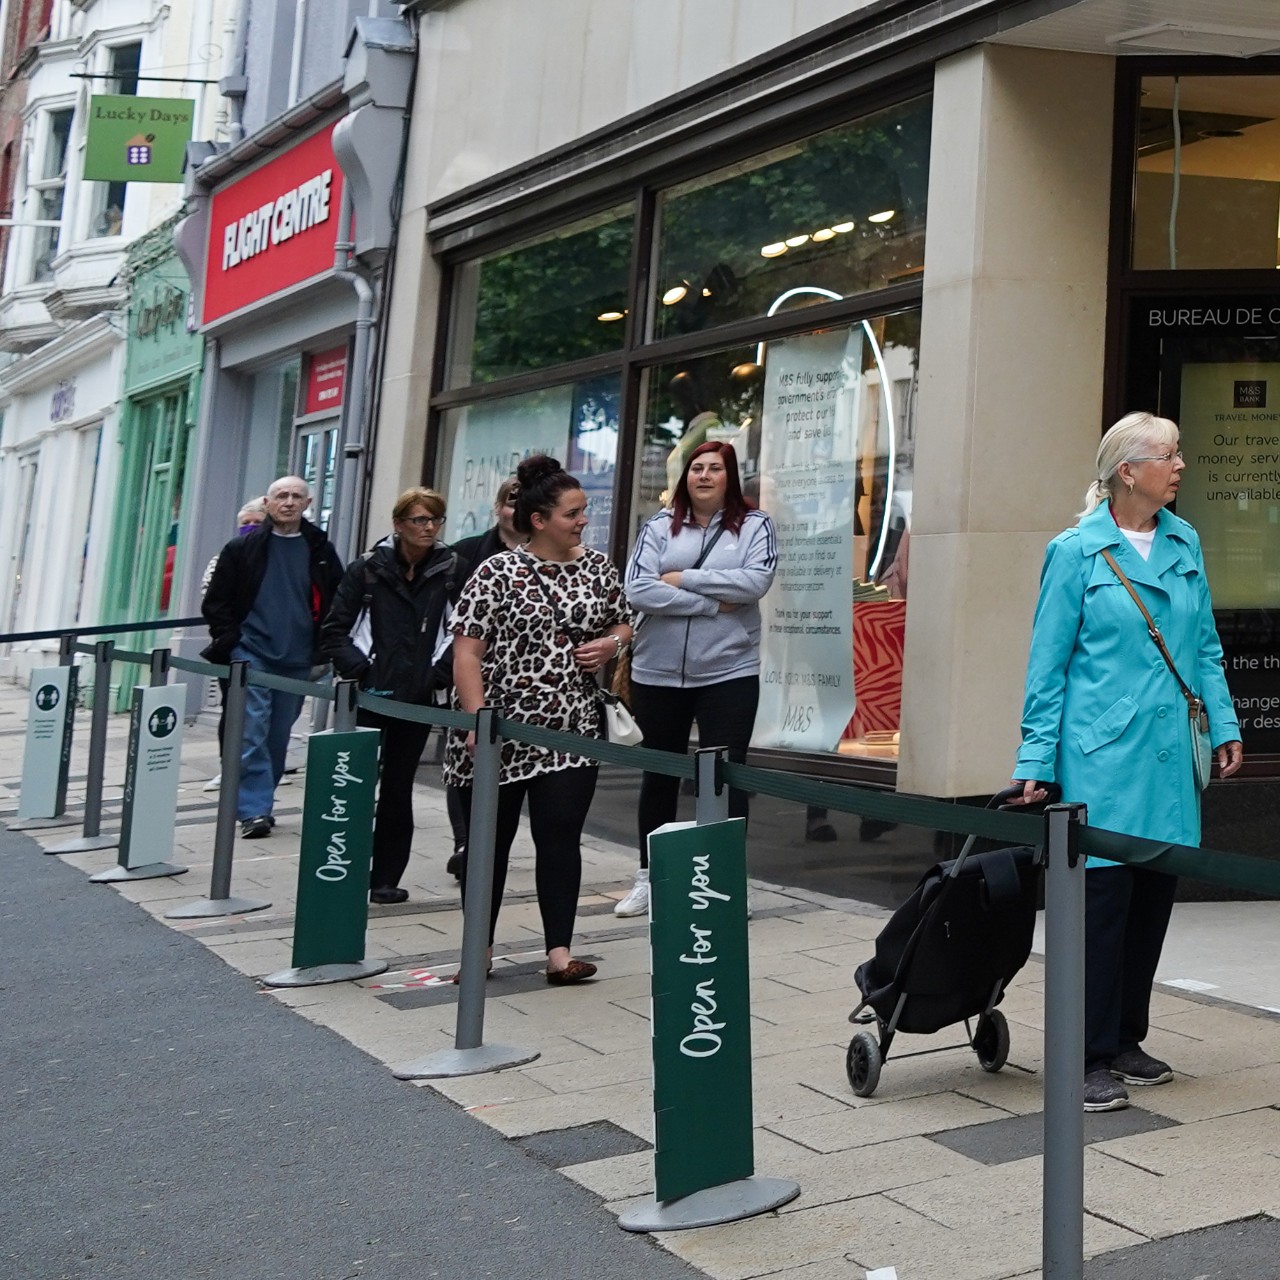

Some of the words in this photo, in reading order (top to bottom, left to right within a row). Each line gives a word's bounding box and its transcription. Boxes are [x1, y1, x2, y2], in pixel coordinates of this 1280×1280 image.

[96, 107, 146, 124] Lucky
[151, 108, 189, 126] Days
[222, 201, 275, 271] FLIGHT
[271, 169, 332, 245] CENTRE
[1149, 308, 1230, 326] BUREAU
[1236, 308, 1262, 325] DE
[779, 373, 793, 388] M&S
[796, 372, 813, 387] fully
[777, 389, 823, 409] government's
[1239, 386, 1261, 395] M&S
[786, 409, 813, 424] protect
[1214, 413, 1247, 421] TRAVEL
[788, 427, 801, 441] and
[804, 428, 821, 440] save
[1213, 434, 1239, 446] Our
[1197, 455, 1243, 467] money
[462, 448, 555, 499] RAINB
[1208, 471, 1218, 483] is
[812, 609, 833, 621] support
[1219, 660, 1227, 669] n
[1233, 656, 1259, 669] the
[764, 671, 782, 685] LOVE
[783, 672, 799, 686] YOUR
[818, 673, 841, 687] FAMILY
[782, 705, 814, 733] M&S
[331, 751, 363, 787] you
[321, 795, 349, 822] for
[315, 831, 352, 882] Open
[688, 854, 731, 910] you
[679, 923, 717, 965] for
[679, 978, 726, 1058] Open
